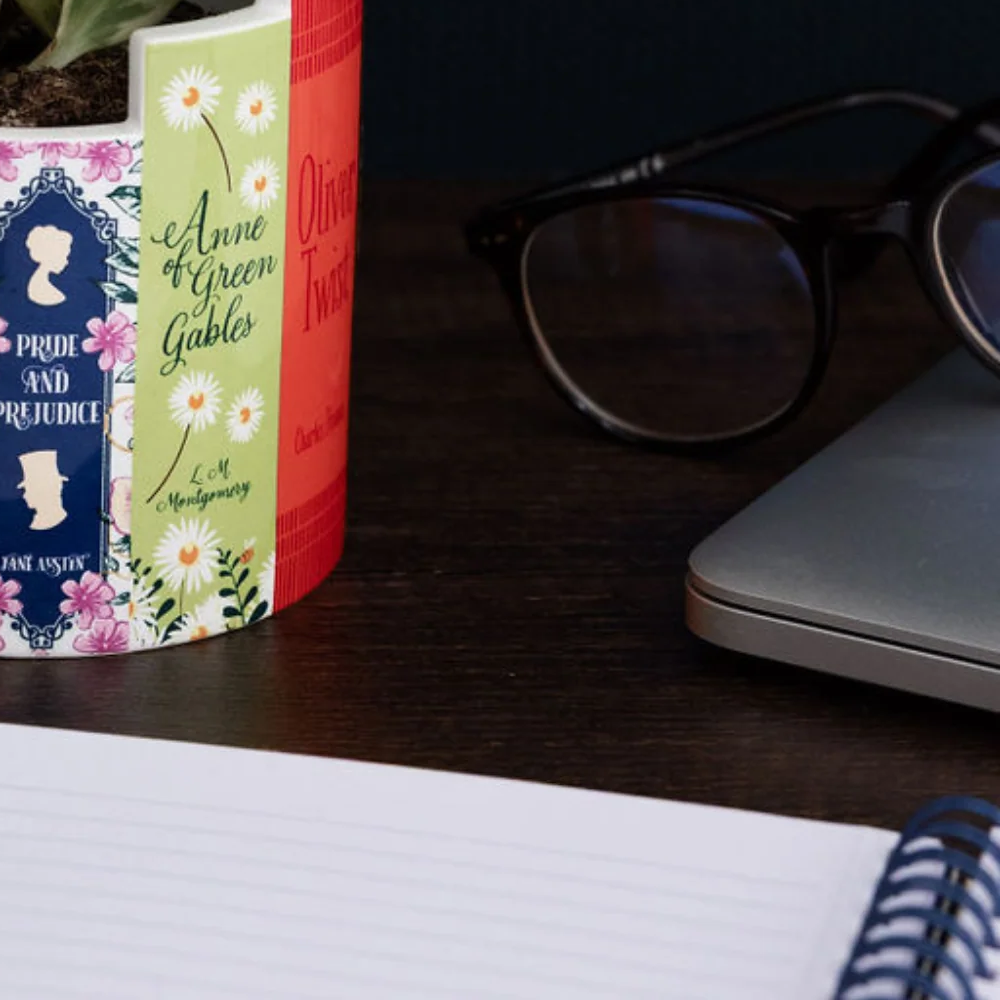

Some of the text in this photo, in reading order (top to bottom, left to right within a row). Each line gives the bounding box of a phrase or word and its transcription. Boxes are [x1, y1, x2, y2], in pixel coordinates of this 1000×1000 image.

[150, 189, 267, 255] Anne
[298, 153, 356, 245] Oliver
[162, 238, 278, 318] of Green
[300, 240, 349, 334] Twist
[16, 333, 79, 362] PRIDE
[160, 294, 256, 376] Gables
[21, 363, 70, 395] AND
[156, 480, 251, 513] Montgomery
[1, 552, 90, 577] JANE AUSTEN
